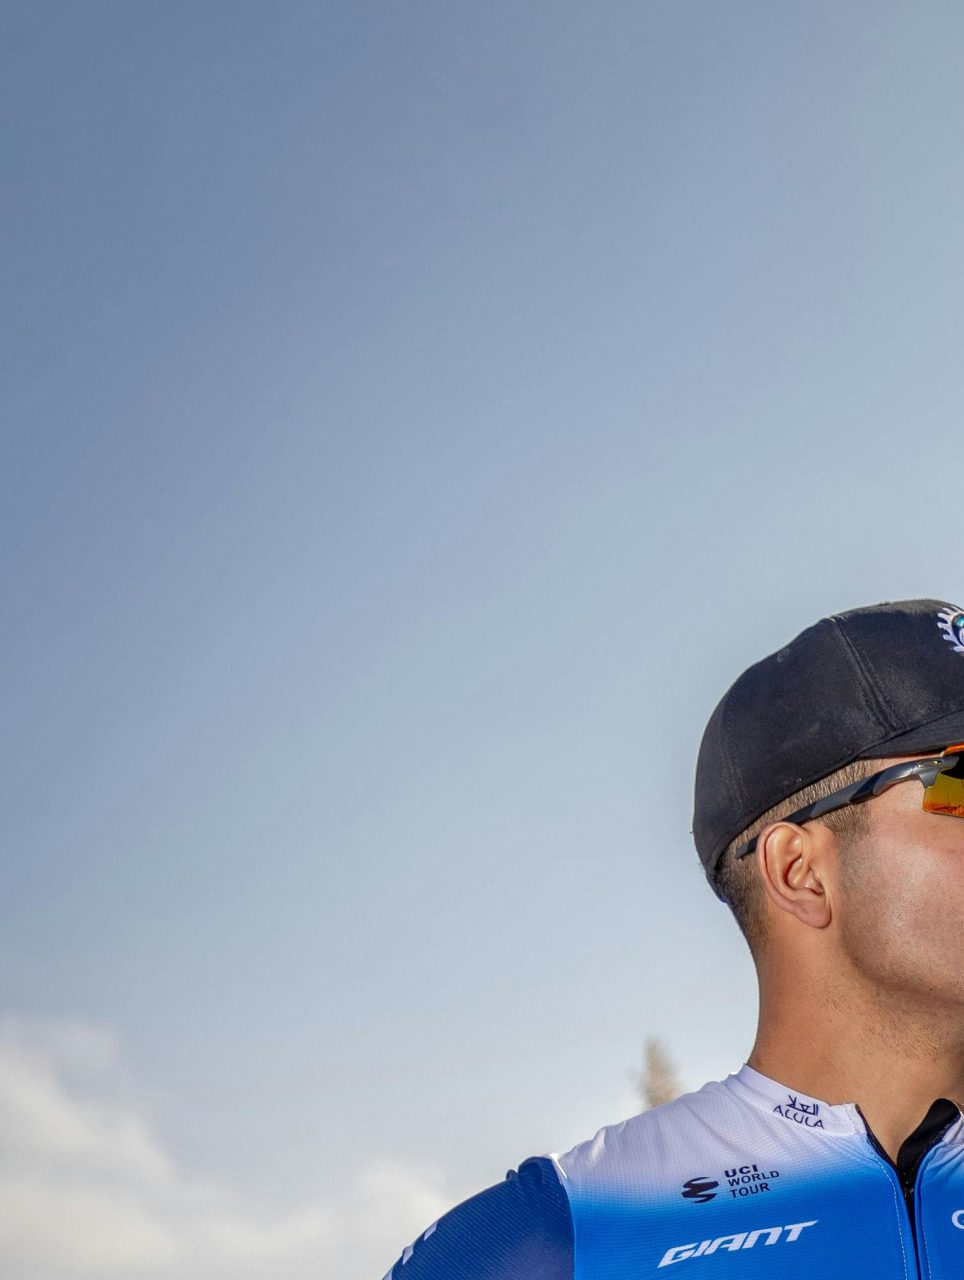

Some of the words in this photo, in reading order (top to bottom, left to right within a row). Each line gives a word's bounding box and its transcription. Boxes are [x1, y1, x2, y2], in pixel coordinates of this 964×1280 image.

[773, 1104, 825, 1130] ALULA
[724, 1164, 759, 1178] UCI
[728, 1170, 780, 1187] WORLD
[730, 1182, 771, 1199] TOUR
[656, 1219, 819, 1269] GIANT
